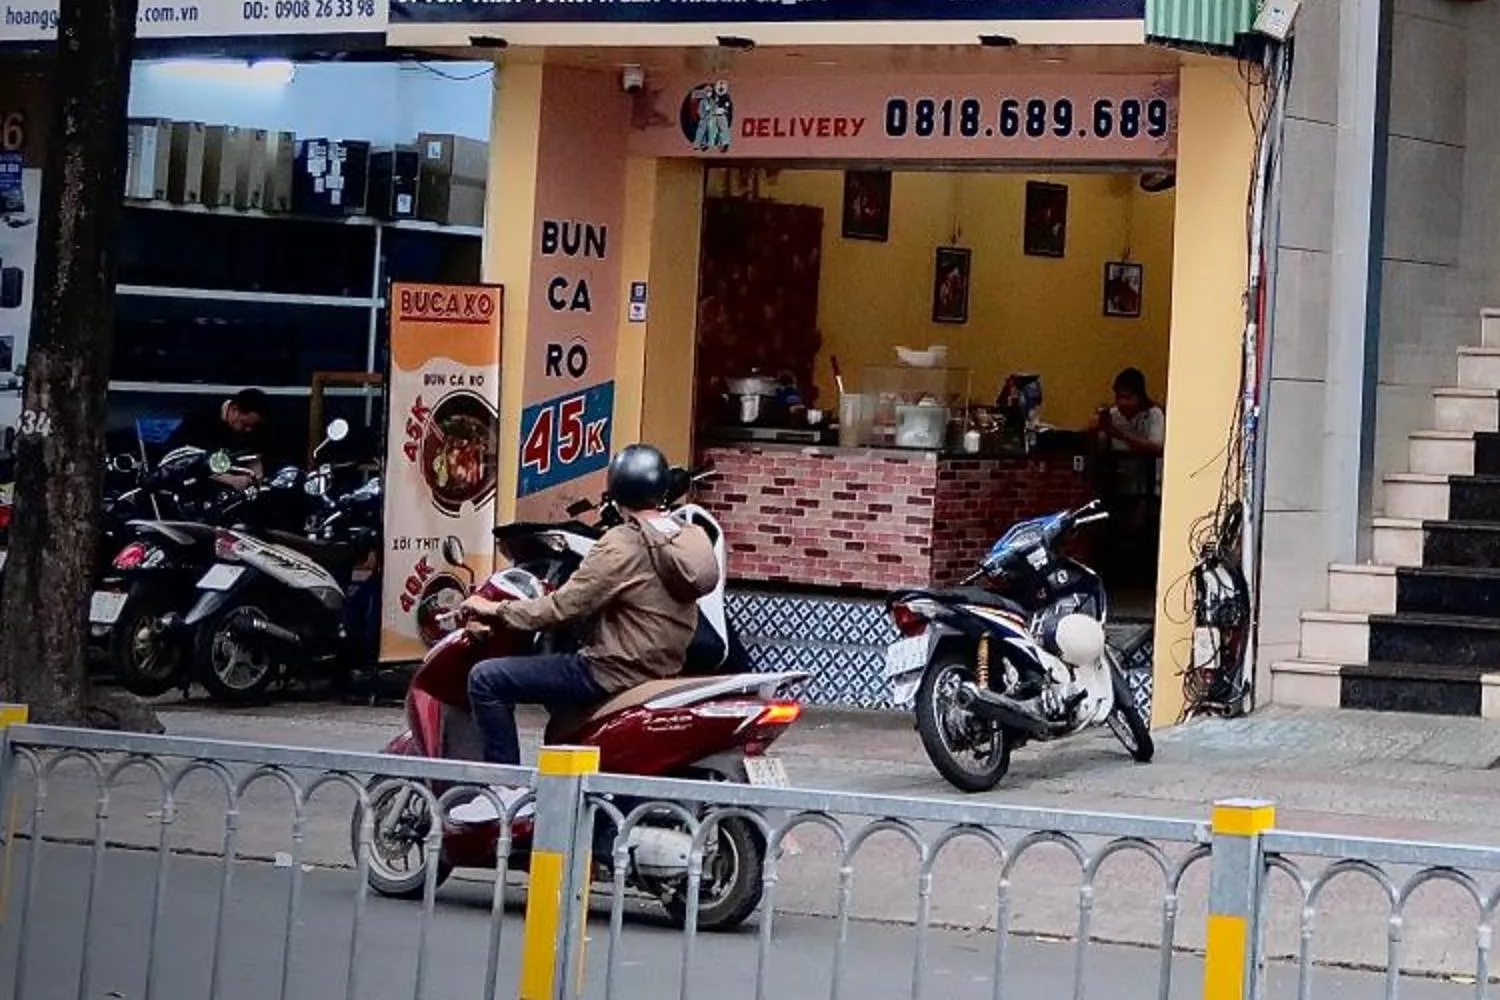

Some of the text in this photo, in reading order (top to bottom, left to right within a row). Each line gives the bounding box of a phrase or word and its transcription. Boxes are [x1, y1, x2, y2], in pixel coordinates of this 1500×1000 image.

[275, 0, 309, 20] 0908
[315, 0, 333, 19] 26
[335, 0, 354, 18] 33
[741, 116, 866, 138] DELIVERY
[884, 97, 1169, 138] 0818.689.689
[400, 289, 495, 317] BUCAXO
[545, 336, 588, 378] RÔ
[521, 396, 608, 475] 45K
